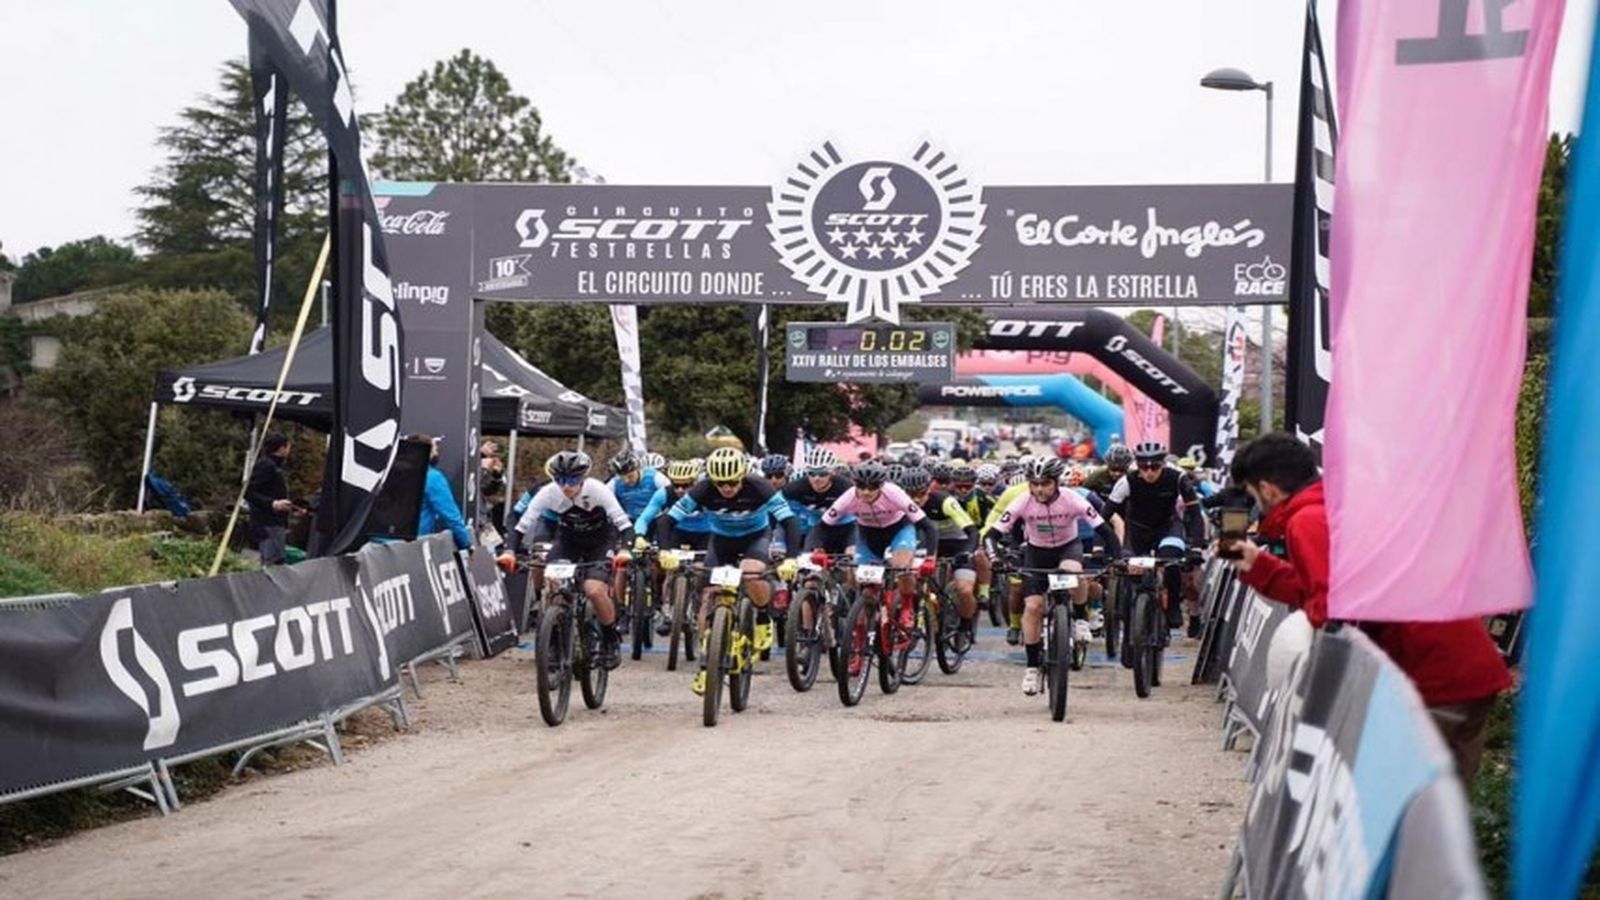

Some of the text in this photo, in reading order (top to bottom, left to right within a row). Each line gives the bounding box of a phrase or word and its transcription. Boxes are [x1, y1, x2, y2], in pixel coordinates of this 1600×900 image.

[566, 206, 753, 216] CIRCUITO
[824, 213, 928, 226] SCOTT
[552, 218, 752, 240] SCOTT
[1015, 207, 1265, 259] El Corte Inglés
[578, 271, 598, 294] EL
[605, 271, 692, 295] CIRCUITO
[700, 271, 764, 295] DONDE
[990, 272, 1013, 298] TÚ
[1021, 275, 1068, 298] ERES
[1076, 275, 1099, 298] LA
[1107, 275, 1199, 298] ESTRELLA
[1234, 281, 1286, 296] RACE
[987, 320, 1085, 338] OTT
[791, 355, 948, 368] XXIV RALLY DE LOS EMBALSES
[1122, 349, 1190, 397] SCOTT
[198, 384, 322, 405] SCOTT
[177, 597, 353, 698] SCOTT
